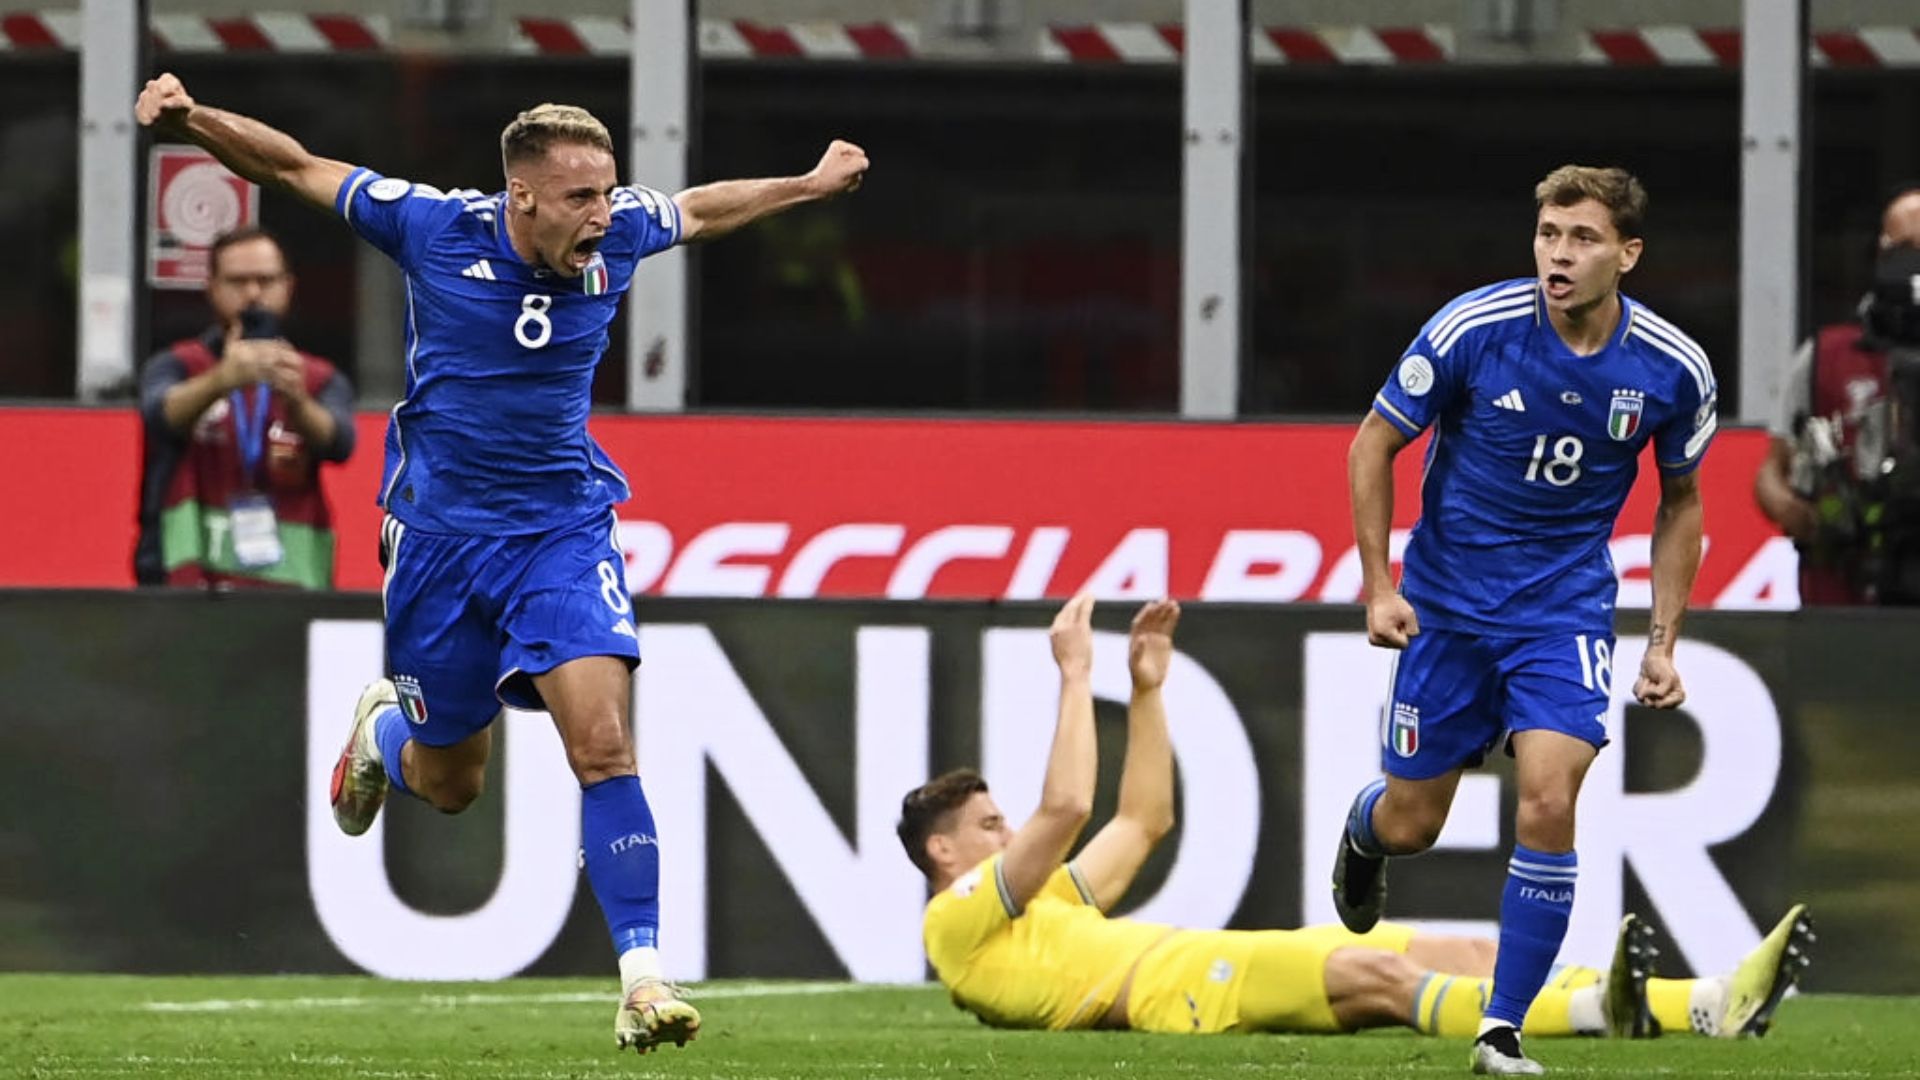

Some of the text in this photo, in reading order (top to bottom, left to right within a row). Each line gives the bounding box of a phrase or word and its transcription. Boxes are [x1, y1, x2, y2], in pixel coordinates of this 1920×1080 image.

[514, 293, 553, 350] 8
[1611, 399, 1642, 412] ITALIA
[1523, 433, 1585, 487] 18
[596, 558, 631, 616] 8
[1574, 634, 1614, 697] 18
[305, 620, 1800, 996] UNDER
[1519, 886, 1573, 903] ITALIA
